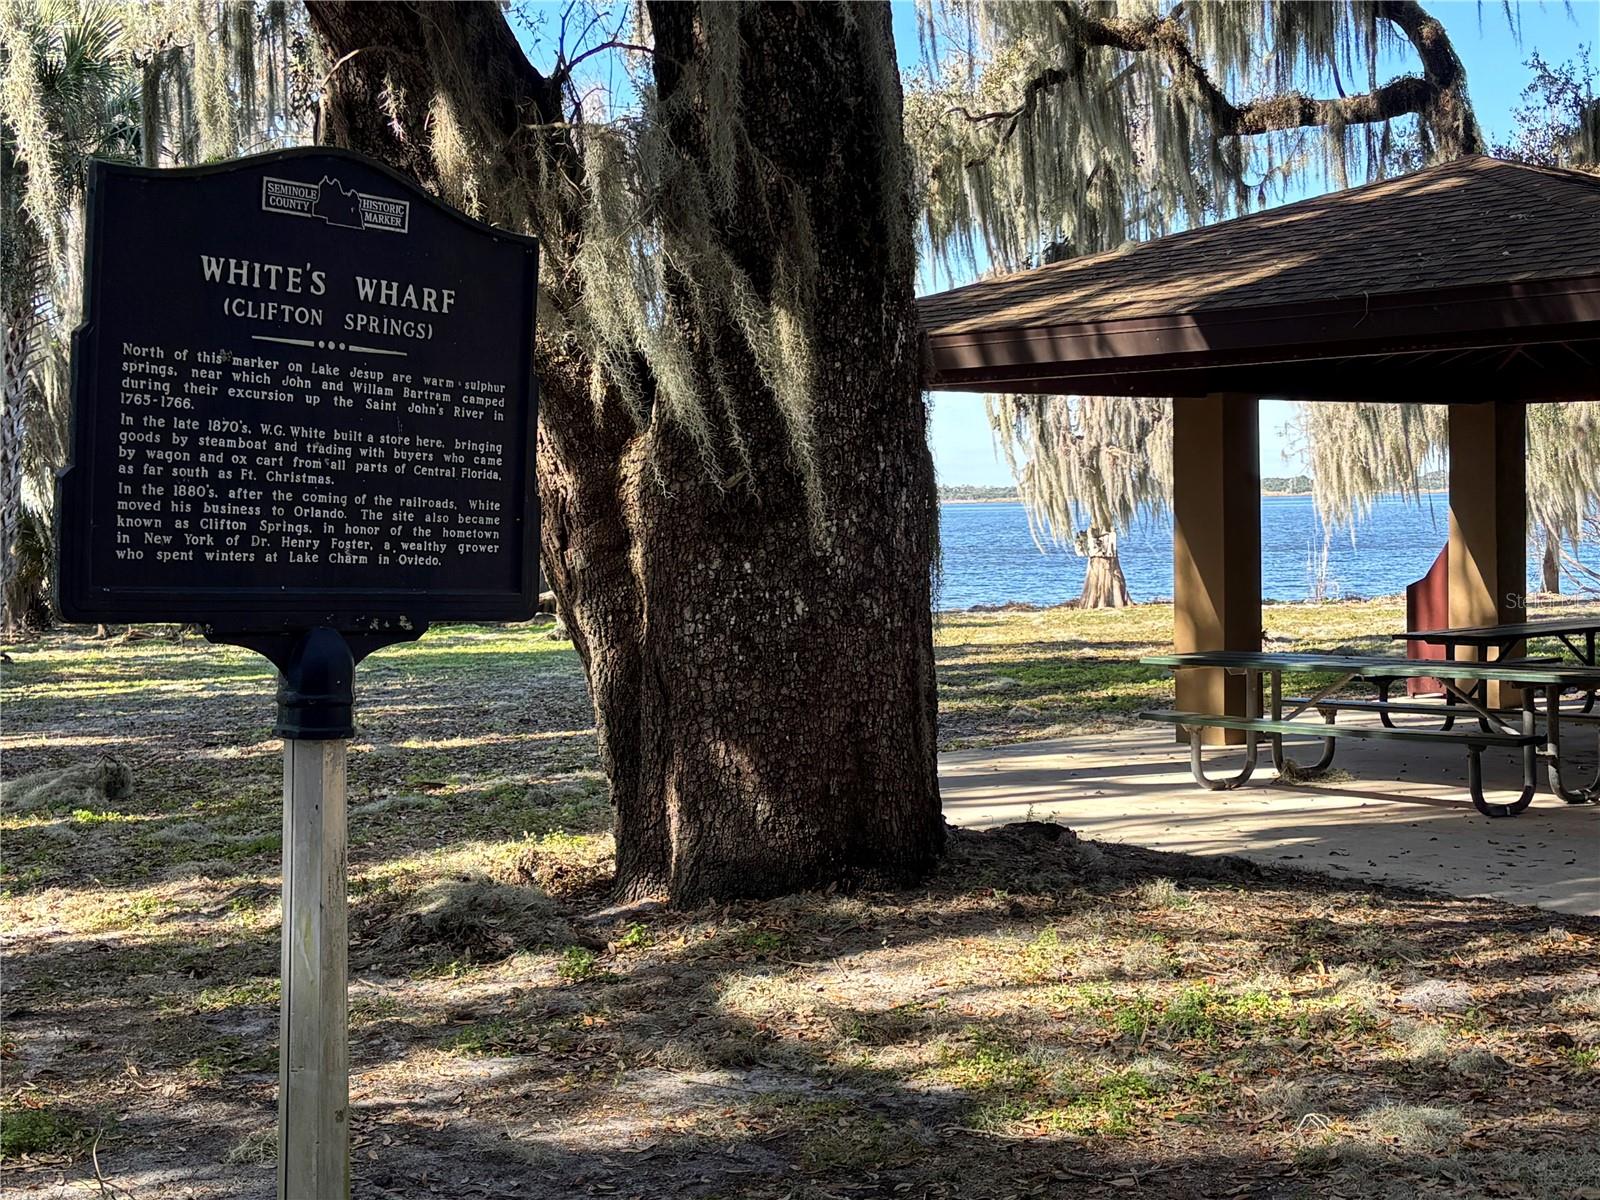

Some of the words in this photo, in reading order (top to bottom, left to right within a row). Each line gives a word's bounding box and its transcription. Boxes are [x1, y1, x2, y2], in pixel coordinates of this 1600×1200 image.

[267, 182, 317, 200] SEMINOLE
[269, 195, 309, 211] COUNTY
[363, 199, 405, 215] HISTORIC
[364, 211, 402, 226] MARKER
[200, 254, 326, 296] WHITE'S
[355, 276, 456, 314] WHARF
[223, 297, 323, 326] (CLIFTON
[343, 313, 433, 340] SPRINGS)
[122, 342, 165, 359] North
[173, 348, 189, 361] of
[196, 350, 224, 365] this
[231, 355, 280, 370] marker
[287, 362, 303, 373] on
[311, 362, 340, 377] Lake
[349, 366, 384, 383] Jesup
[392, 373, 412, 384] are
[422, 376, 455, 389] warm
[464, 380, 506, 394] sulphur
[120, 391, 195, 410] 1765-1766.
[121, 376, 171, 396] during
[183, 381, 219, 396] their
[227, 387, 294, 403] excursion
[304, 394, 321, 407] up
[333, 395, 354, 408] the
[365, 397, 397, 412] Saint
[407, 402, 444, 416] John's
[453, 405, 485, 420] River
[493, 409, 504, 422] in
[191, 368, 223, 380] near
[231, 370, 271, 385] which
[281, 374, 312, 389] John
[321, 380, 344, 392] and
[352, 381, 394, 397] Willam
[402, 386, 452, 403] Bartram
[461, 394, 505, 409] camped
[120, 412, 134, 426] In
[142, 414, 166, 428] the
[173, 416, 200, 430] late
[259, 423, 286, 437] W.G.
[289, 425, 326, 441] White
[333, 428, 363, 442] built
[366, 433, 374, 444] a
[379, 433, 411, 446] store
[454, 438, 503, 456] bringing
[118, 444, 136, 461] by
[145, 449, 191, 464] wagon
[199, 451, 224, 464] and
[231, 454, 248, 465] ox
[255, 455, 284, 467] cart
[292, 456, 322, 470] from
[330, 459, 346, 471] all
[355, 462, 388, 474] parts
[394, 463, 407, 475] of
[413, 464, 456, 478] Central
[119, 431, 161, 445] goods
[171, 432, 189, 448] by
[198, 435, 267, 451] steamboat
[274, 437, 298, 453] and
[306, 441, 352, 459] trading
[358, 445, 385, 459] with
[393, 447, 434, 462] buyers
[442, 452, 465, 464] who
[473, 456, 503, 467] came
[118, 464, 134, 475] as
[143, 462, 164, 476] far
[171, 465, 209, 479] south
[217, 469, 233, 480] as
[240, 468, 257, 481] Ft.
[265, 470, 335, 485] Christmas.
[118, 481, 132, 495] In
[141, 483, 165, 496] the
[228, 487, 264, 500] after
[271, 489, 293, 502] the
[301, 491, 348, 508] coming
[354, 493, 367, 505] of
[373, 494, 393, 506] the
[468, 499, 501, 511] White
[116, 500, 161, 512] moved
[170, 500, 192, 513] his
[202, 501, 261, 516] business
[271, 505, 285, 517] to
[293, 505, 347, 519] Orlando.
[360, 508, 383, 521] The
[391, 510, 415, 522] site
[424, 511, 450, 524] also
[457, 513, 501, 526] became
[116, 514, 162, 529] known
[174, 519, 190, 529] as
[199, 517, 247, 531] Clifton
[323, 521, 335, 534] in
[344, 522, 381, 536] honor
[389, 524, 403, 537] of
[412, 525, 432, 538] the
[442, 526, 500, 540] hometown
[116, 530, 130, 544] in
[144, 531, 173, 545] New
[183, 533, 215, 546] York
[225, 534, 241, 547] of
[250, 534, 271, 547] Dr.
[281, 535, 321, 551] Henry
[383, 541, 391, 551] a
[400, 540, 447, 554] wealthy
[457, 543, 500, 555] grower
[115, 547, 144, 560] who
[156, 549, 194, 563] spent
[204, 549, 255, 562] winters
[264, 551, 278, 563] at
[289, 550, 319, 563] Lake
[328, 551, 368, 565] Charm
[378, 553, 390, 565] in
[398, 553, 442, 566] Oviedo.
